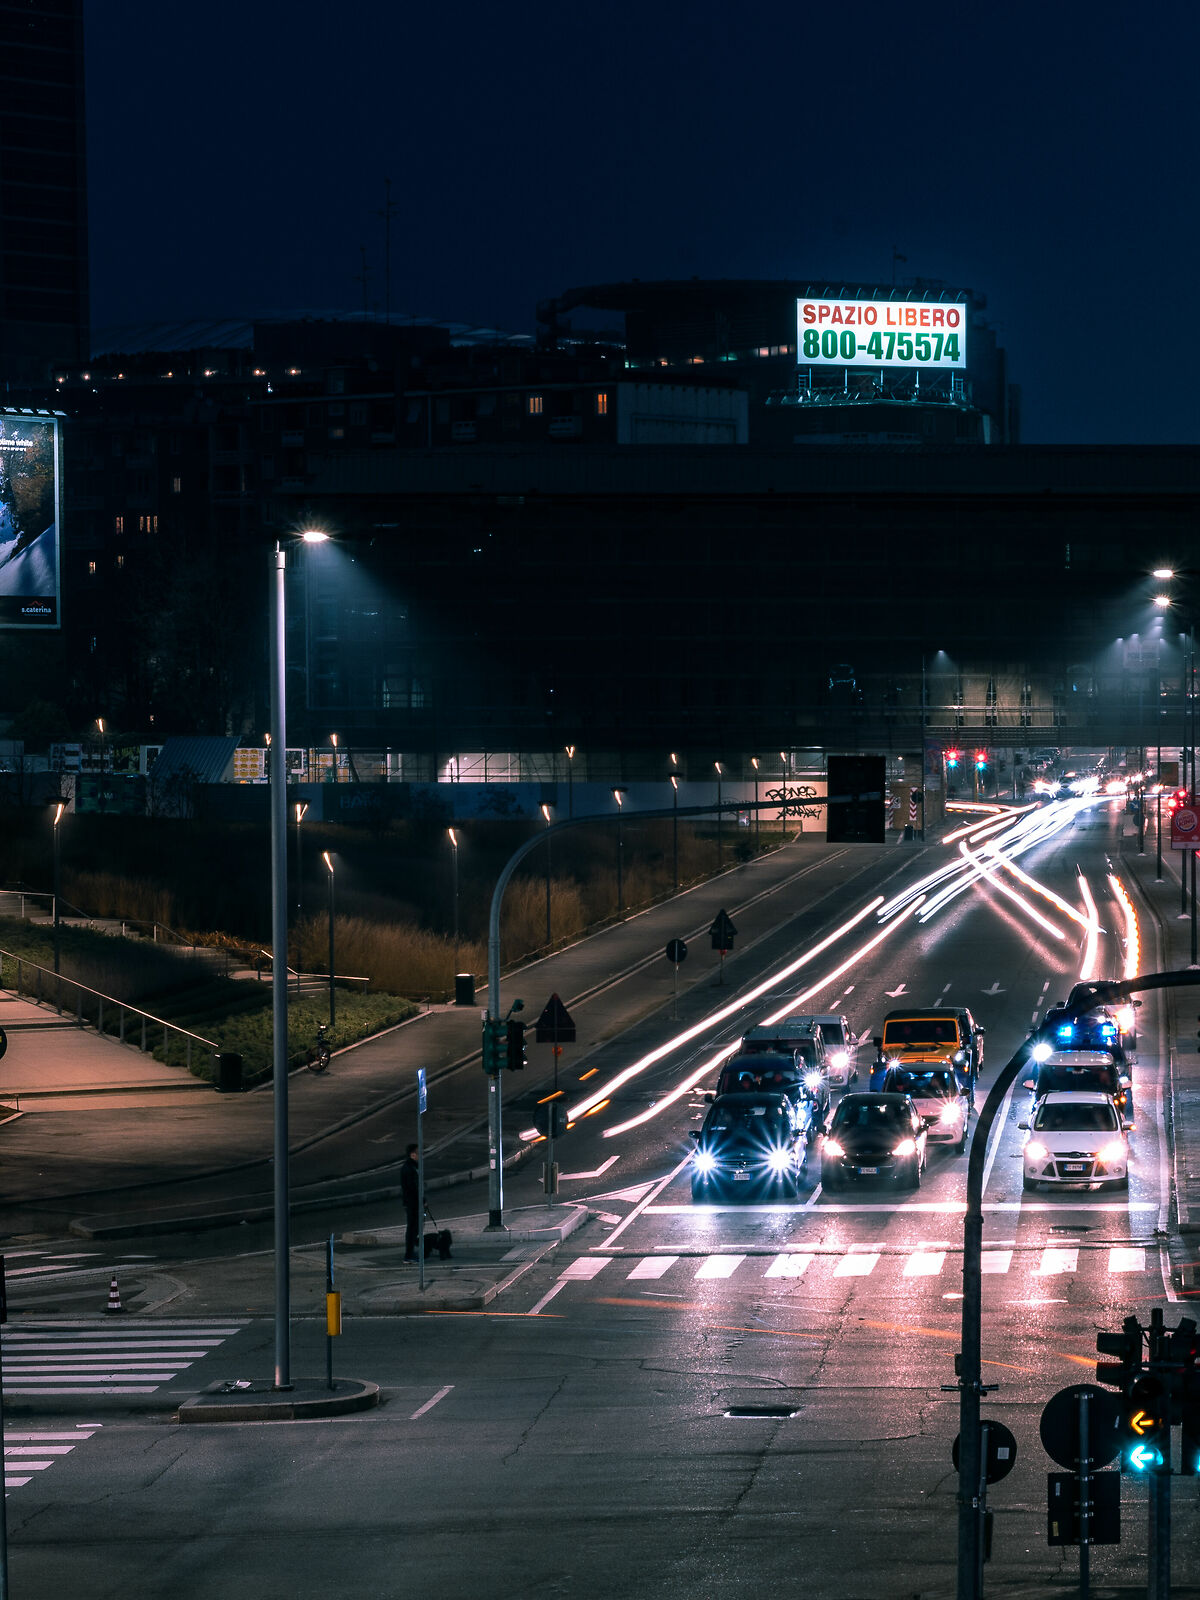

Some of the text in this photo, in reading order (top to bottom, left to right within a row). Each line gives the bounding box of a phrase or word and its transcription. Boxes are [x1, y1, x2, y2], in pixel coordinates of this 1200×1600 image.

[803, 304, 960, 328] SPAZIO LIBERO
[803, 329, 961, 362] 800-475574
